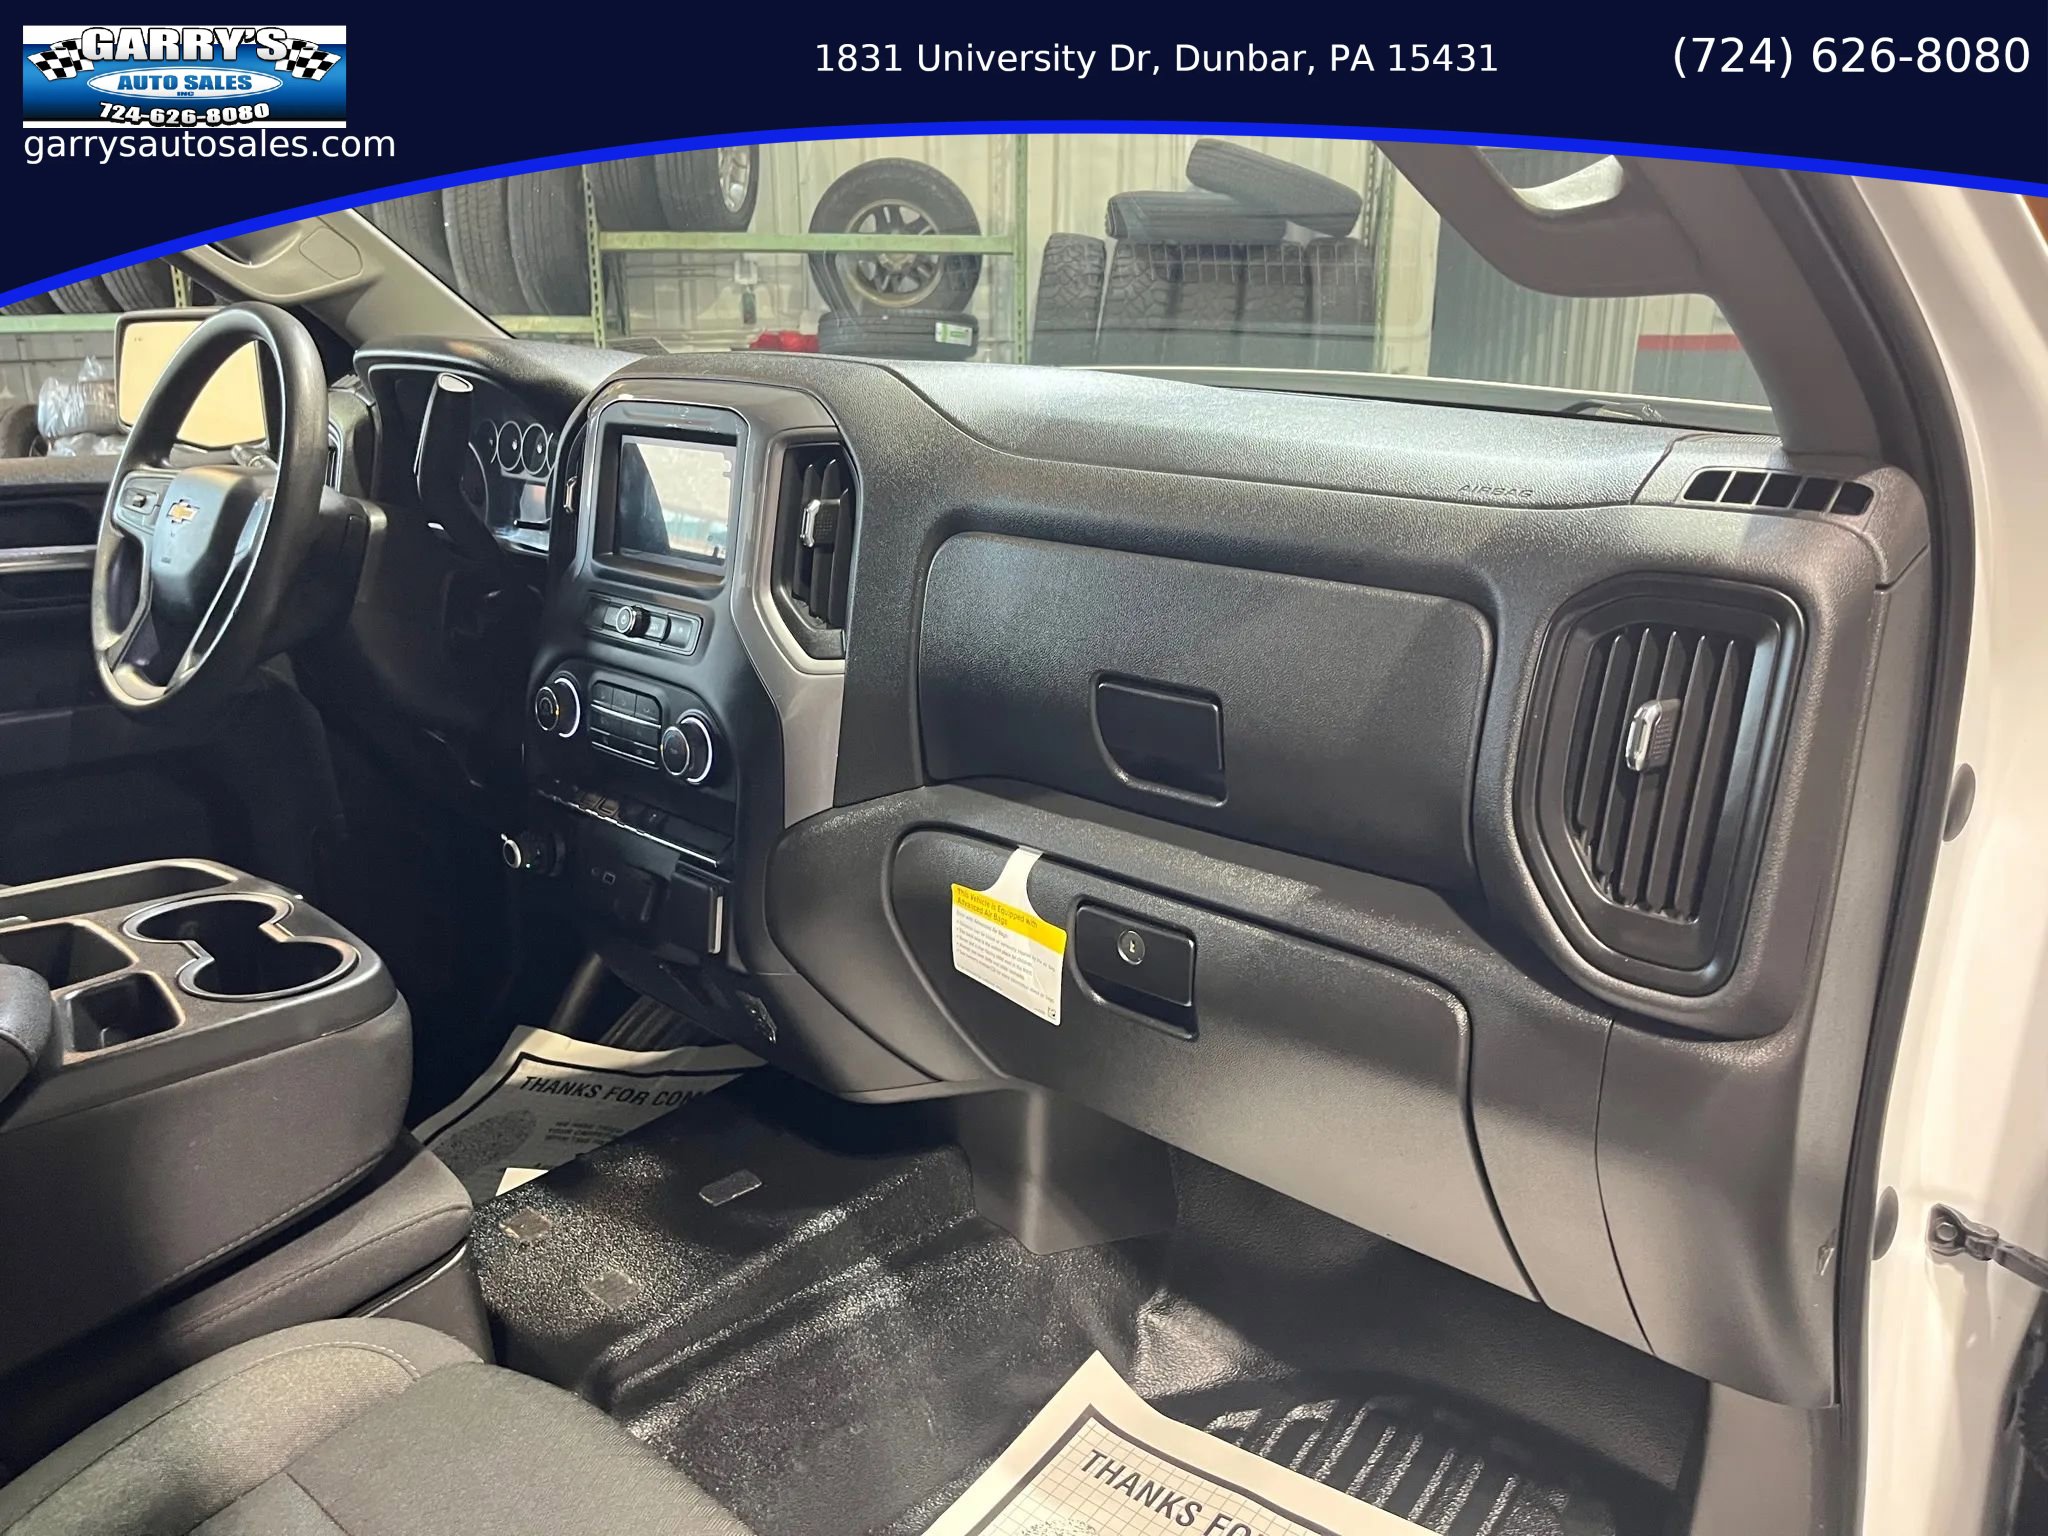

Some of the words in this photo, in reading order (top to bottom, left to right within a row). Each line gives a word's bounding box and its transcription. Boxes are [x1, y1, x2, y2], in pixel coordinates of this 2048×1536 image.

[1458, 484, 1533, 498] AIRBAG
[519, 1076, 602, 1099] THANKS
[603, 1086, 650, 1106] FOR
[1081, 1449, 1203, 1527] THANKS
[1203, 1512, 1265, 1536] FO
